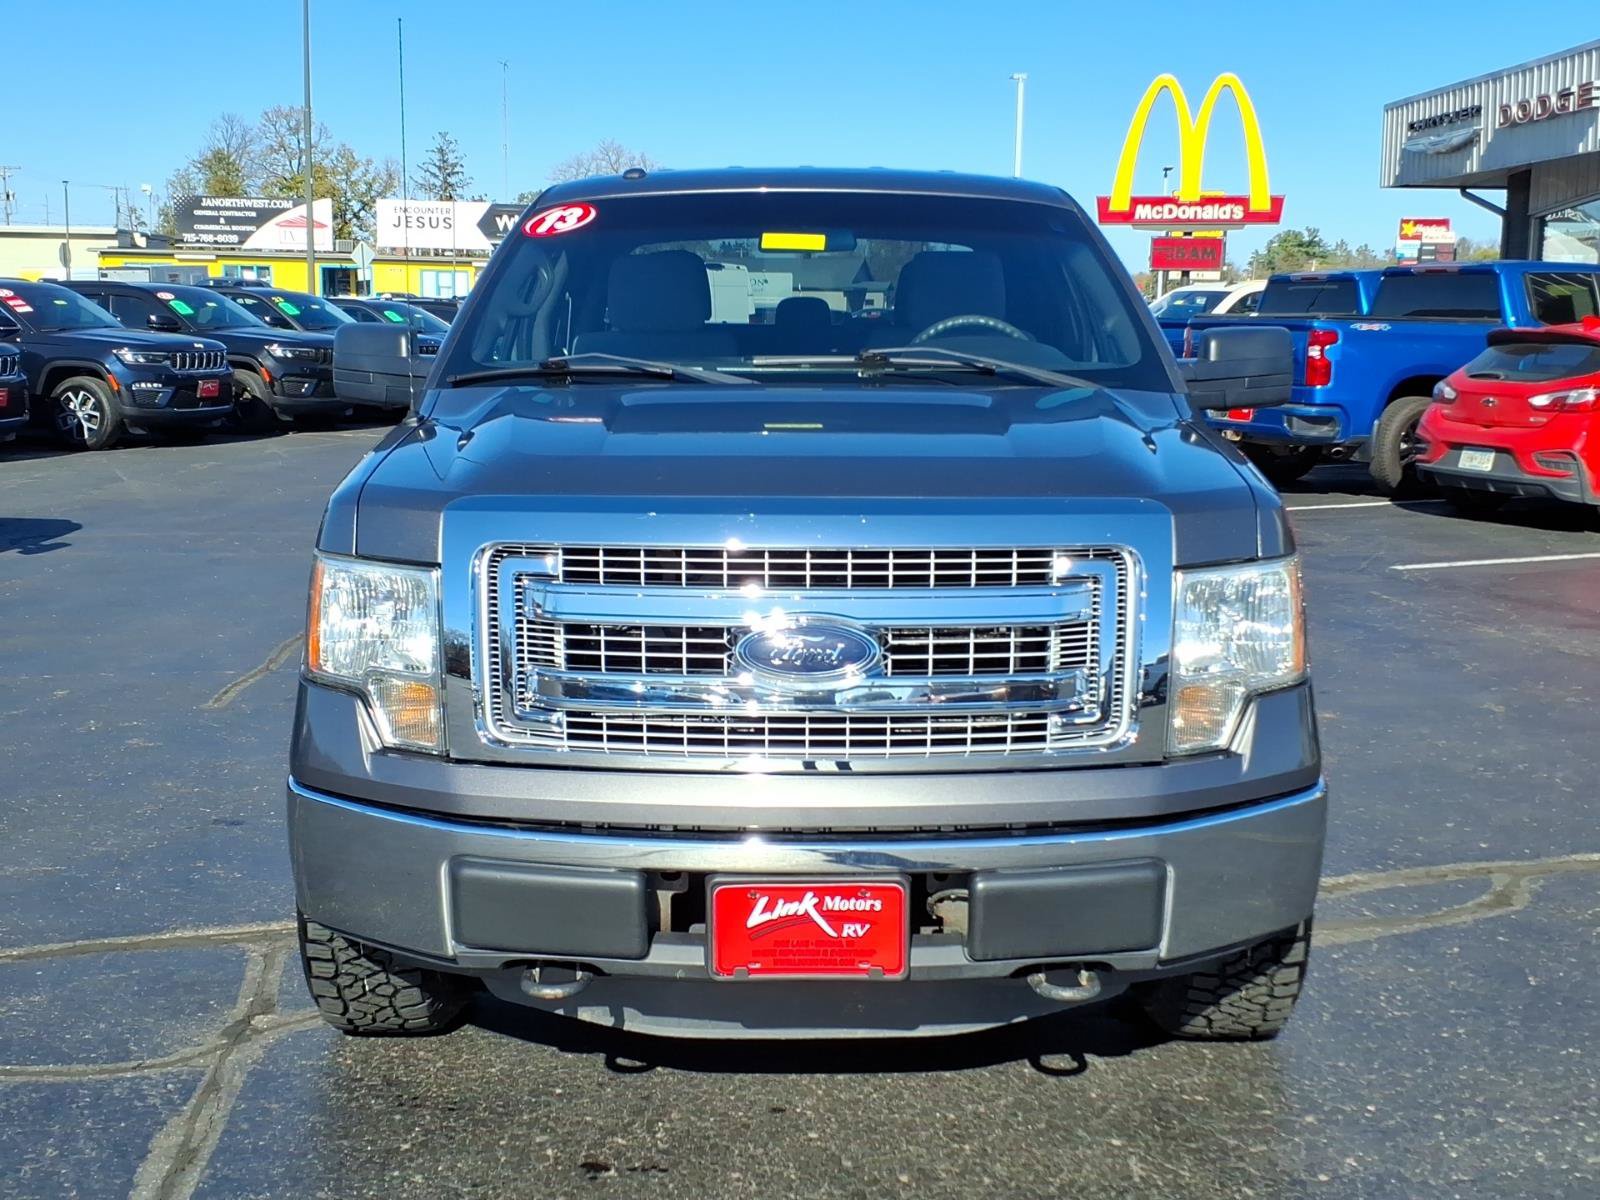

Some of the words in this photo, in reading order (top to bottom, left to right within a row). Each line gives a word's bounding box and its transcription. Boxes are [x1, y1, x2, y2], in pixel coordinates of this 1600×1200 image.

[1499, 82, 1593, 128] DODGE
[200, 197, 293, 209] JANORTHWEST.COM
[394, 206, 451, 215] ENCOUNTER
[1134, 203, 1244, 220] McDonald's
[392, 215, 453, 230] JESUS
[822, 895, 883, 912] Motors
[746, 891, 839, 938] Link
[841, 922, 872, 938] RV
